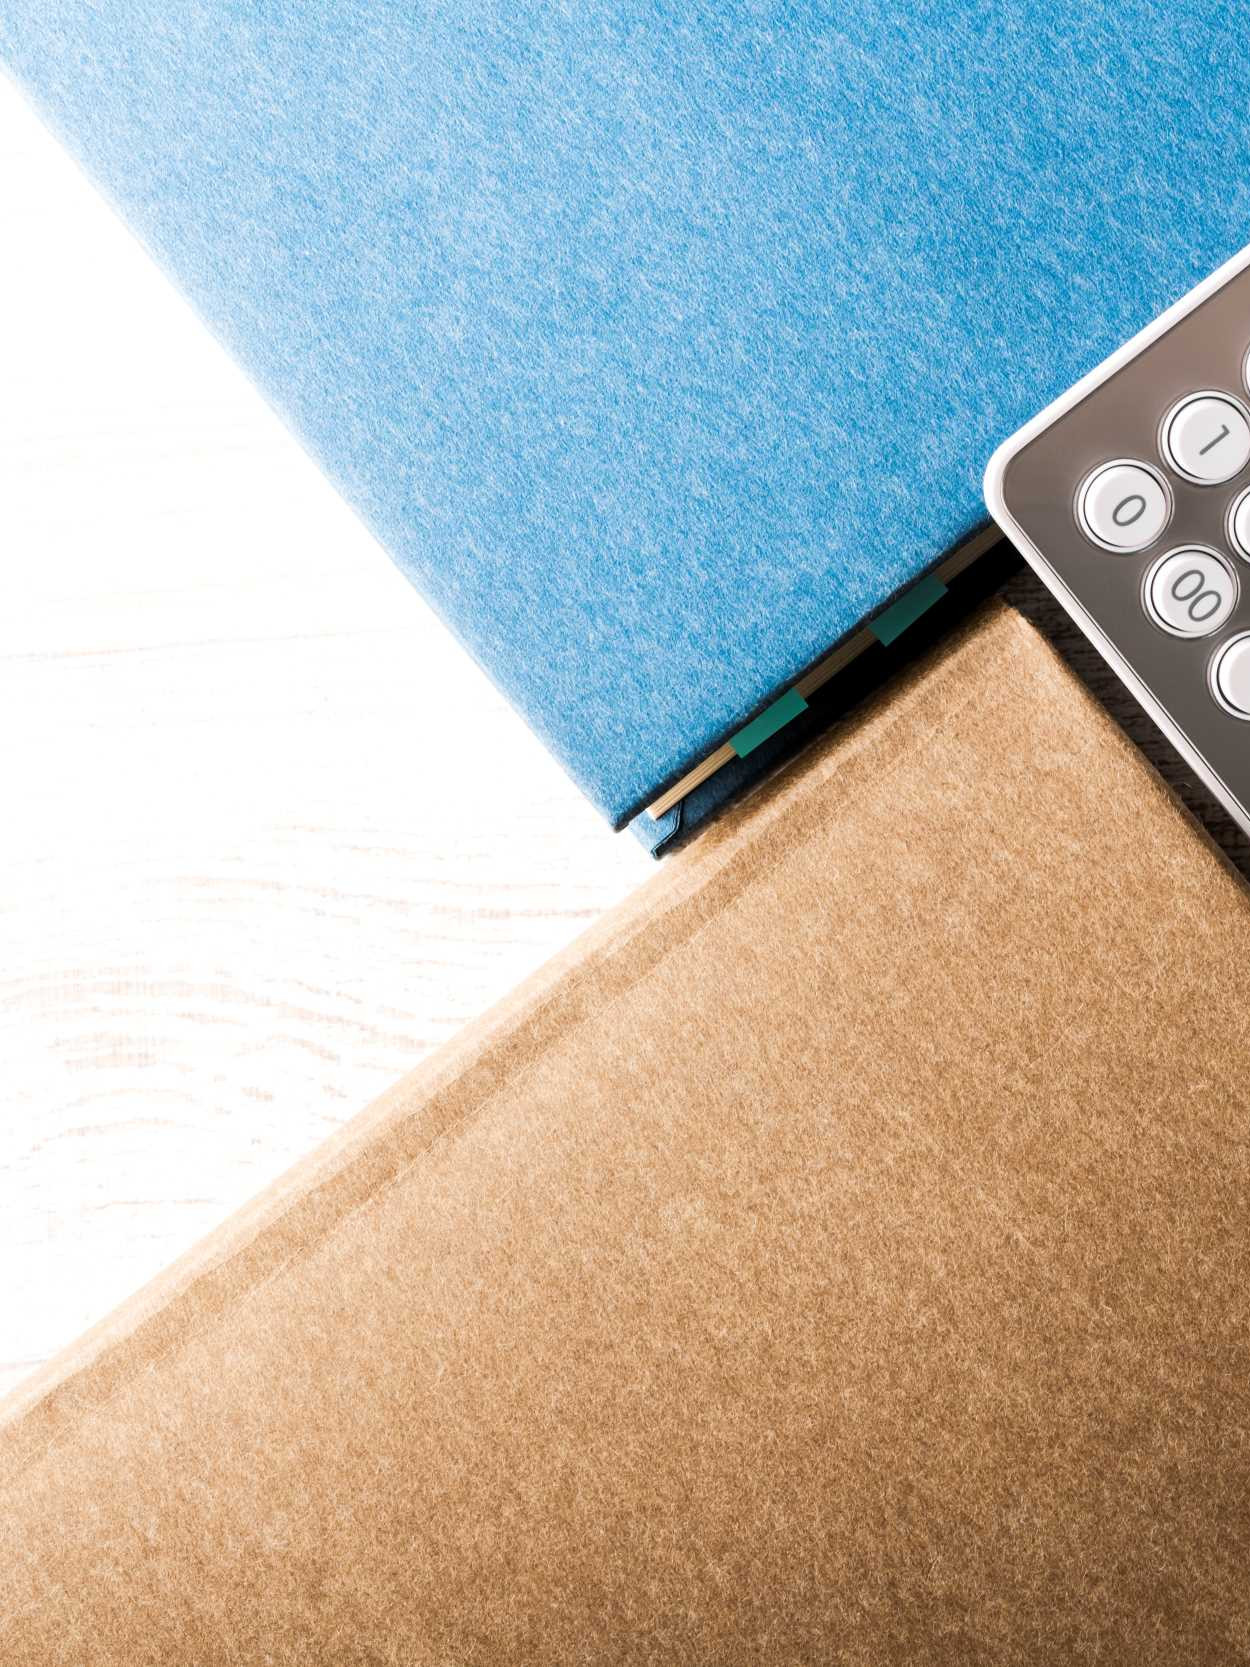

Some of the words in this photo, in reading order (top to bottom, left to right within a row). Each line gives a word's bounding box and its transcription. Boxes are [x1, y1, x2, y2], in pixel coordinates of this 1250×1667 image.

[1200, 425, 1230, 455] 1
[1112, 495, 1146, 526] 0
[1171, 569, 1222, 622] 00
